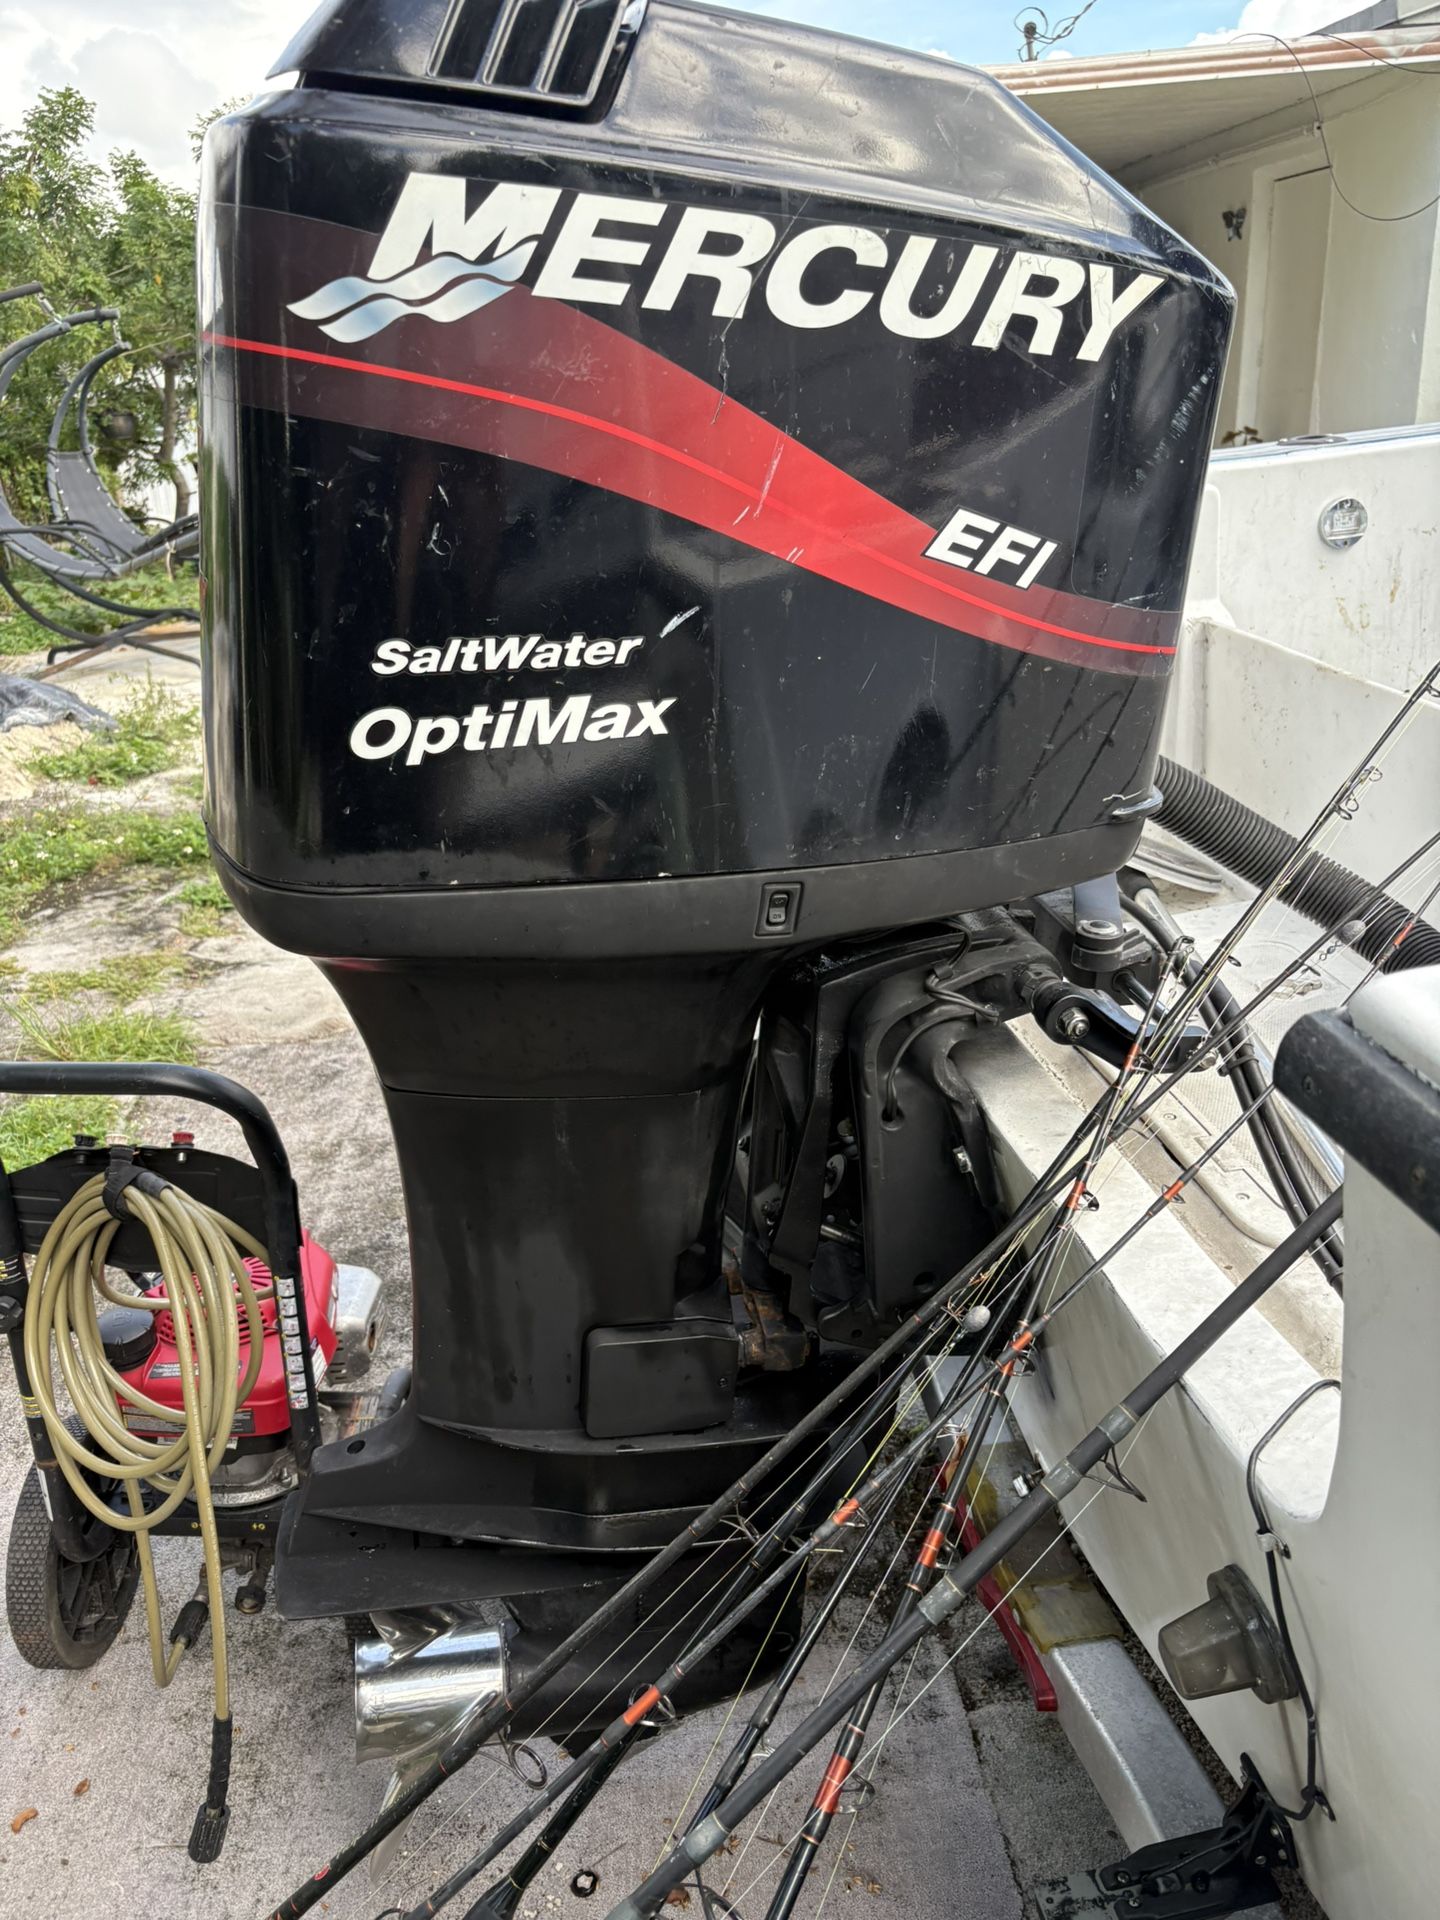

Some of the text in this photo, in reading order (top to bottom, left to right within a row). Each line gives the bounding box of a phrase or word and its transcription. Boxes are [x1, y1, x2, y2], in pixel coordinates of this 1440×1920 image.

[366, 172, 1165, 362] MERCURY
[924, 507, 1058, 589] EFI
[371, 634, 644, 675] SaltWater
[350, 693, 678, 767] OptiMax
